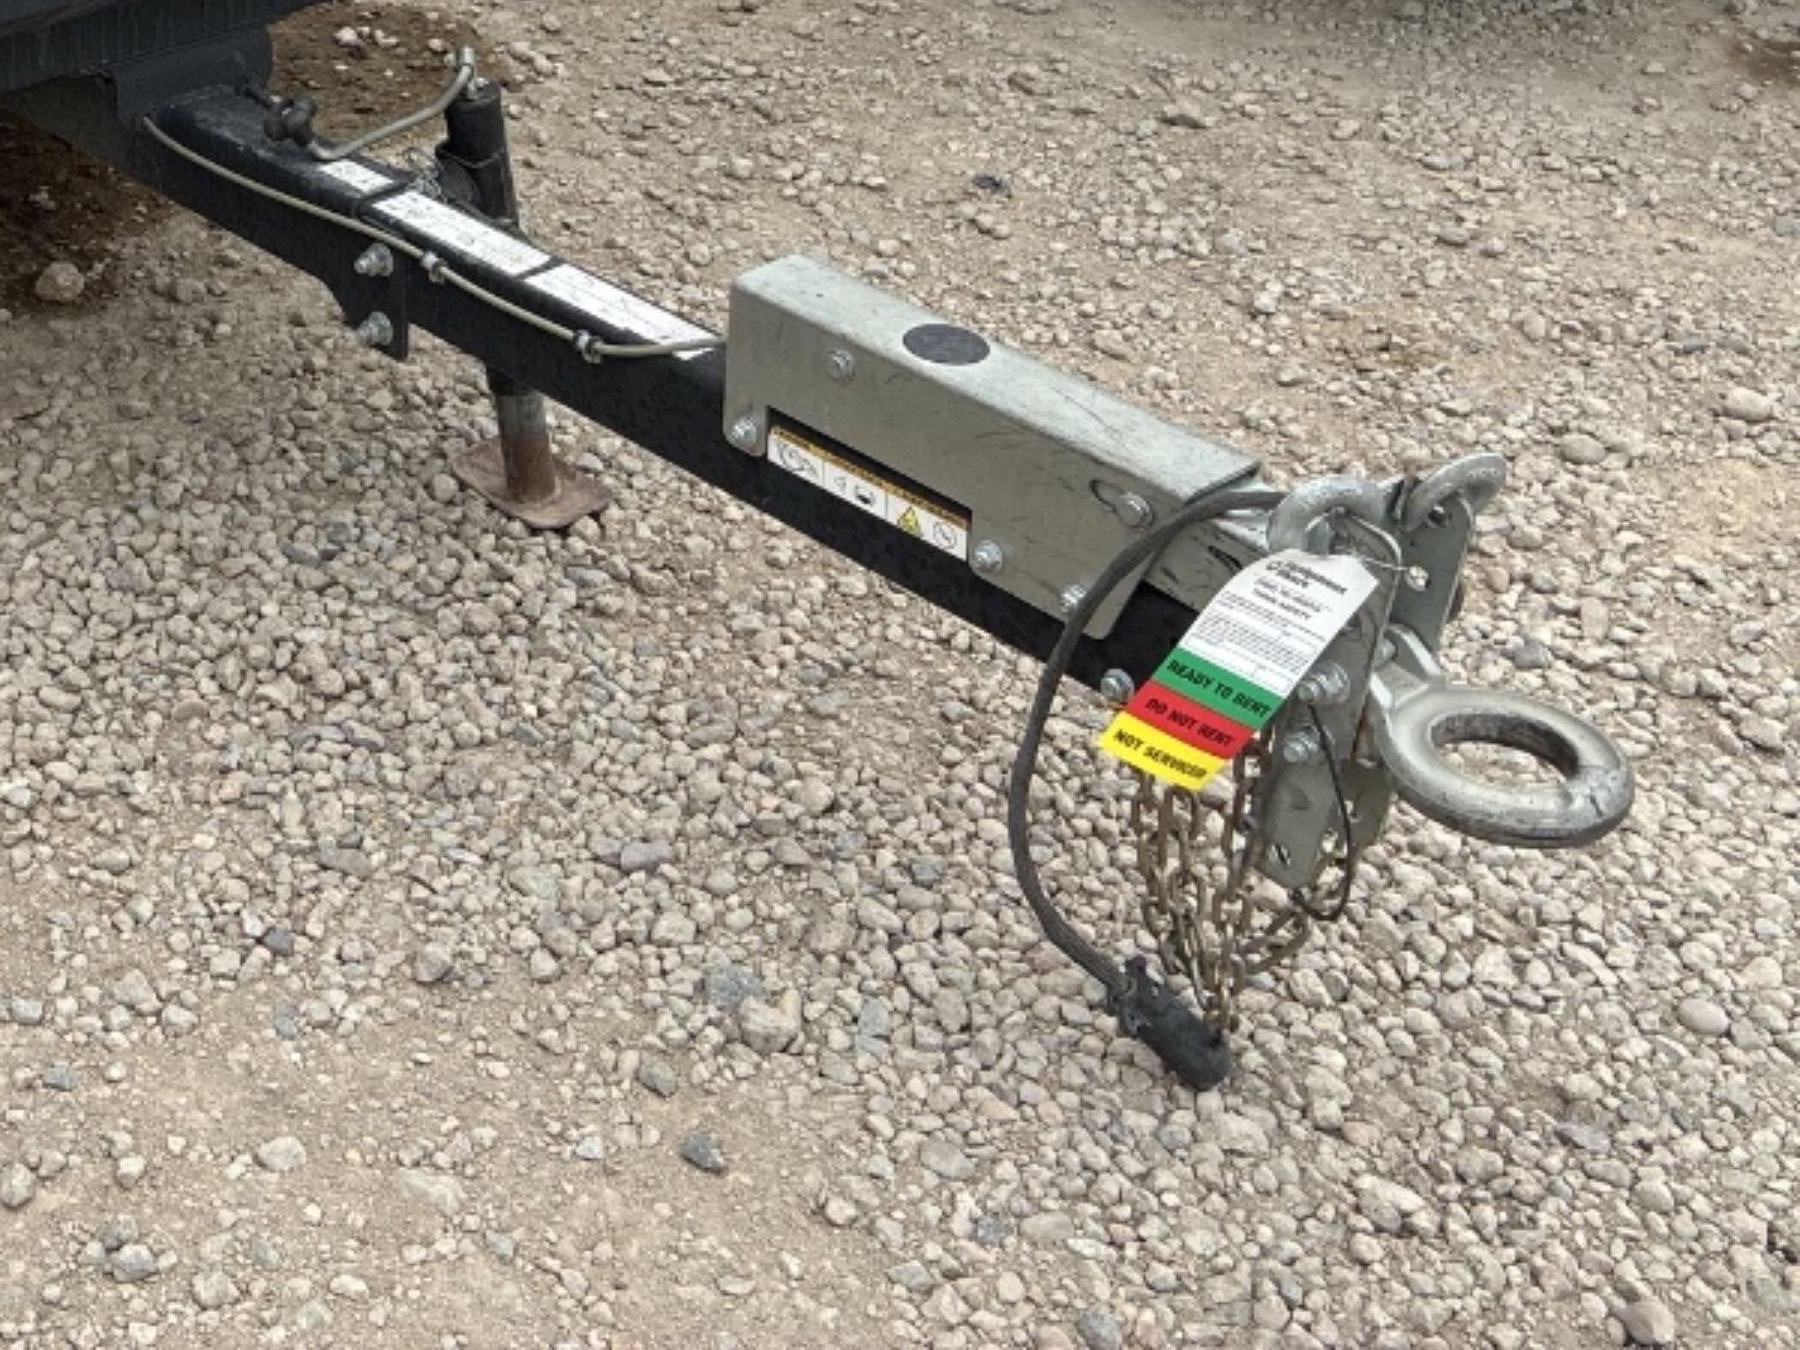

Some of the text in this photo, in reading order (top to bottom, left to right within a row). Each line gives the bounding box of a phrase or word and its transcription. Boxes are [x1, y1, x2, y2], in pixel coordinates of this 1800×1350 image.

[1167, 660, 1270, 717] READY TO RENT
[1145, 698, 1167, 714] DO
[1167, 710, 1197, 728] NOT
[1114, 730, 1142, 750] NOT
